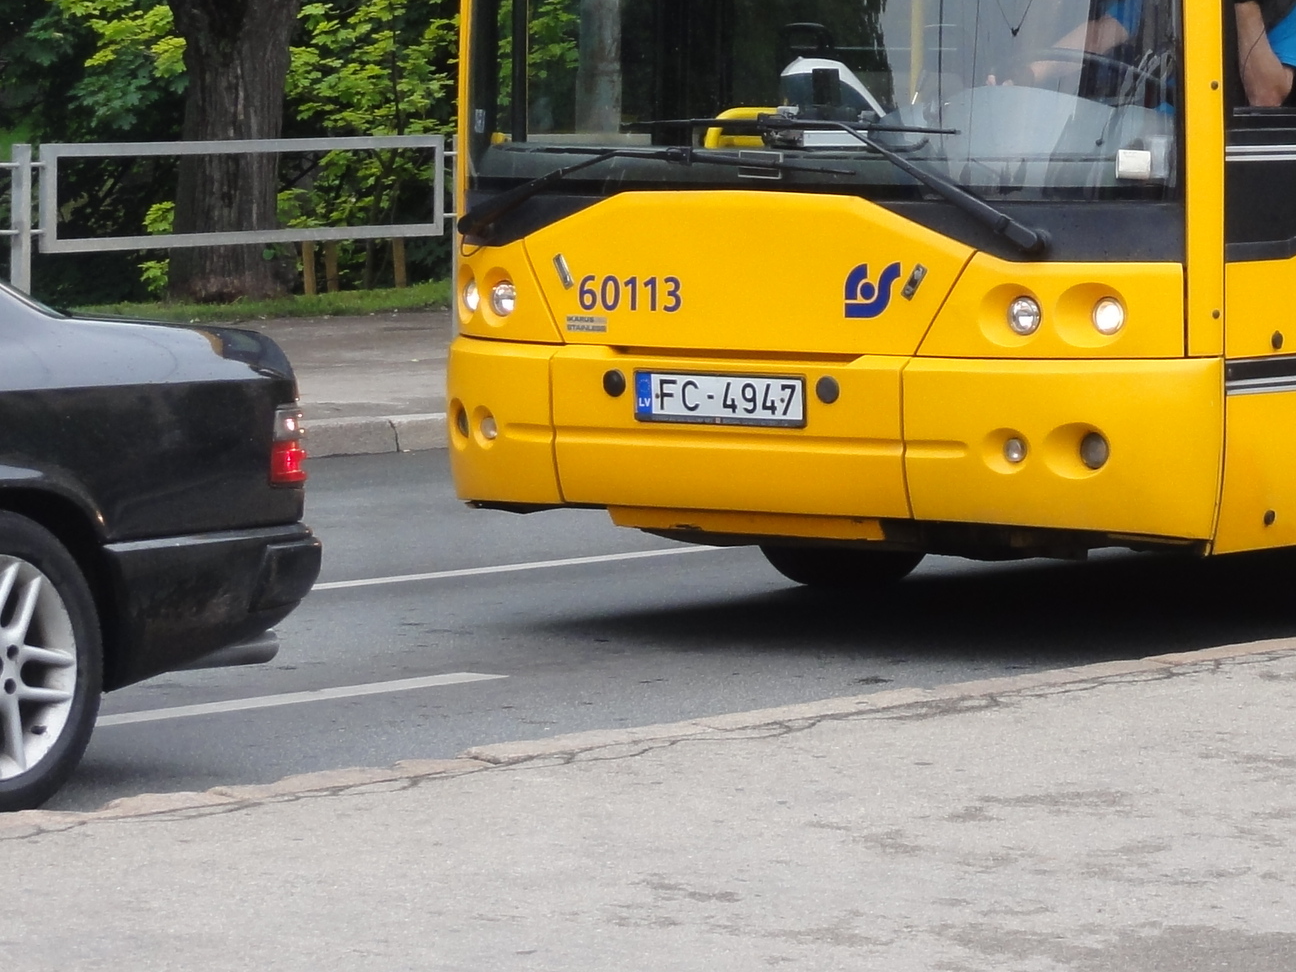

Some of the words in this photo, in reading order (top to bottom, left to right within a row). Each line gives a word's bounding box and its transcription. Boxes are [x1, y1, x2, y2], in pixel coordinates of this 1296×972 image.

[578, 274, 683, 313] 60113
[638, 397, 651, 407] LV
[658, 378, 797, 416] FC-4947
